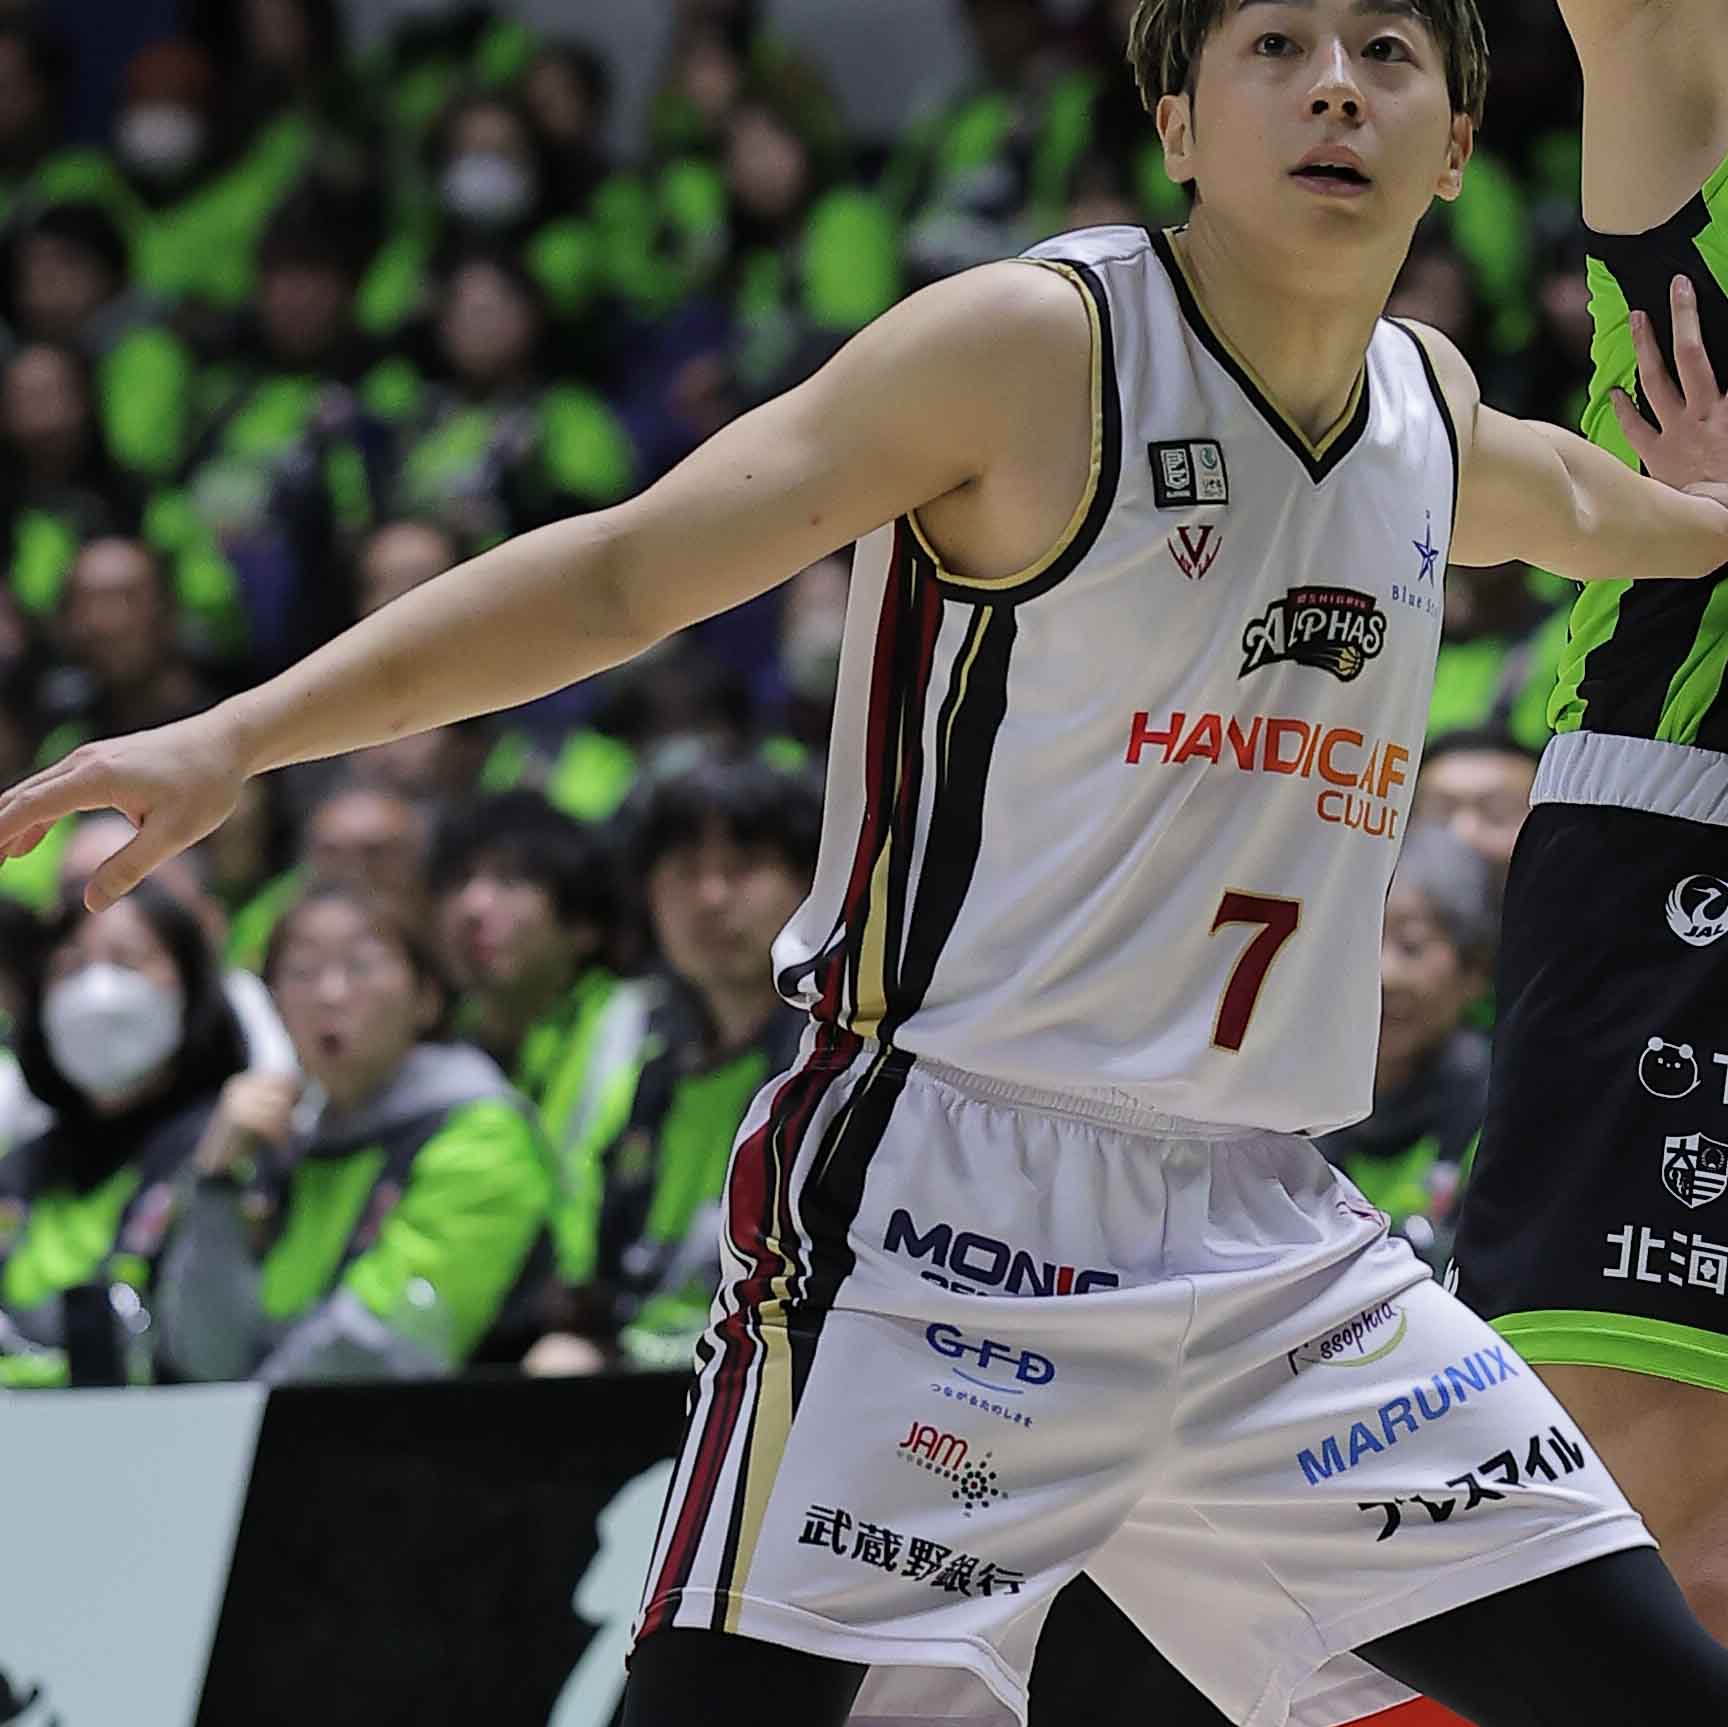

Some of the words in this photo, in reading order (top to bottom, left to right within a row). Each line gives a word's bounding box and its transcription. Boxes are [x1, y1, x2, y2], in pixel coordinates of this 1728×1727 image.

[1244, 606, 1384, 668] ALPHAS
[1207, 887, 1305, 1055] 7
[926, 1322, 1056, 1386] GFD
[899, 1421, 969, 1471] JAM
[1296, 1344, 1520, 1486] MARUNIX
[797, 1503, 1028, 1598] 武蔵野銀行
